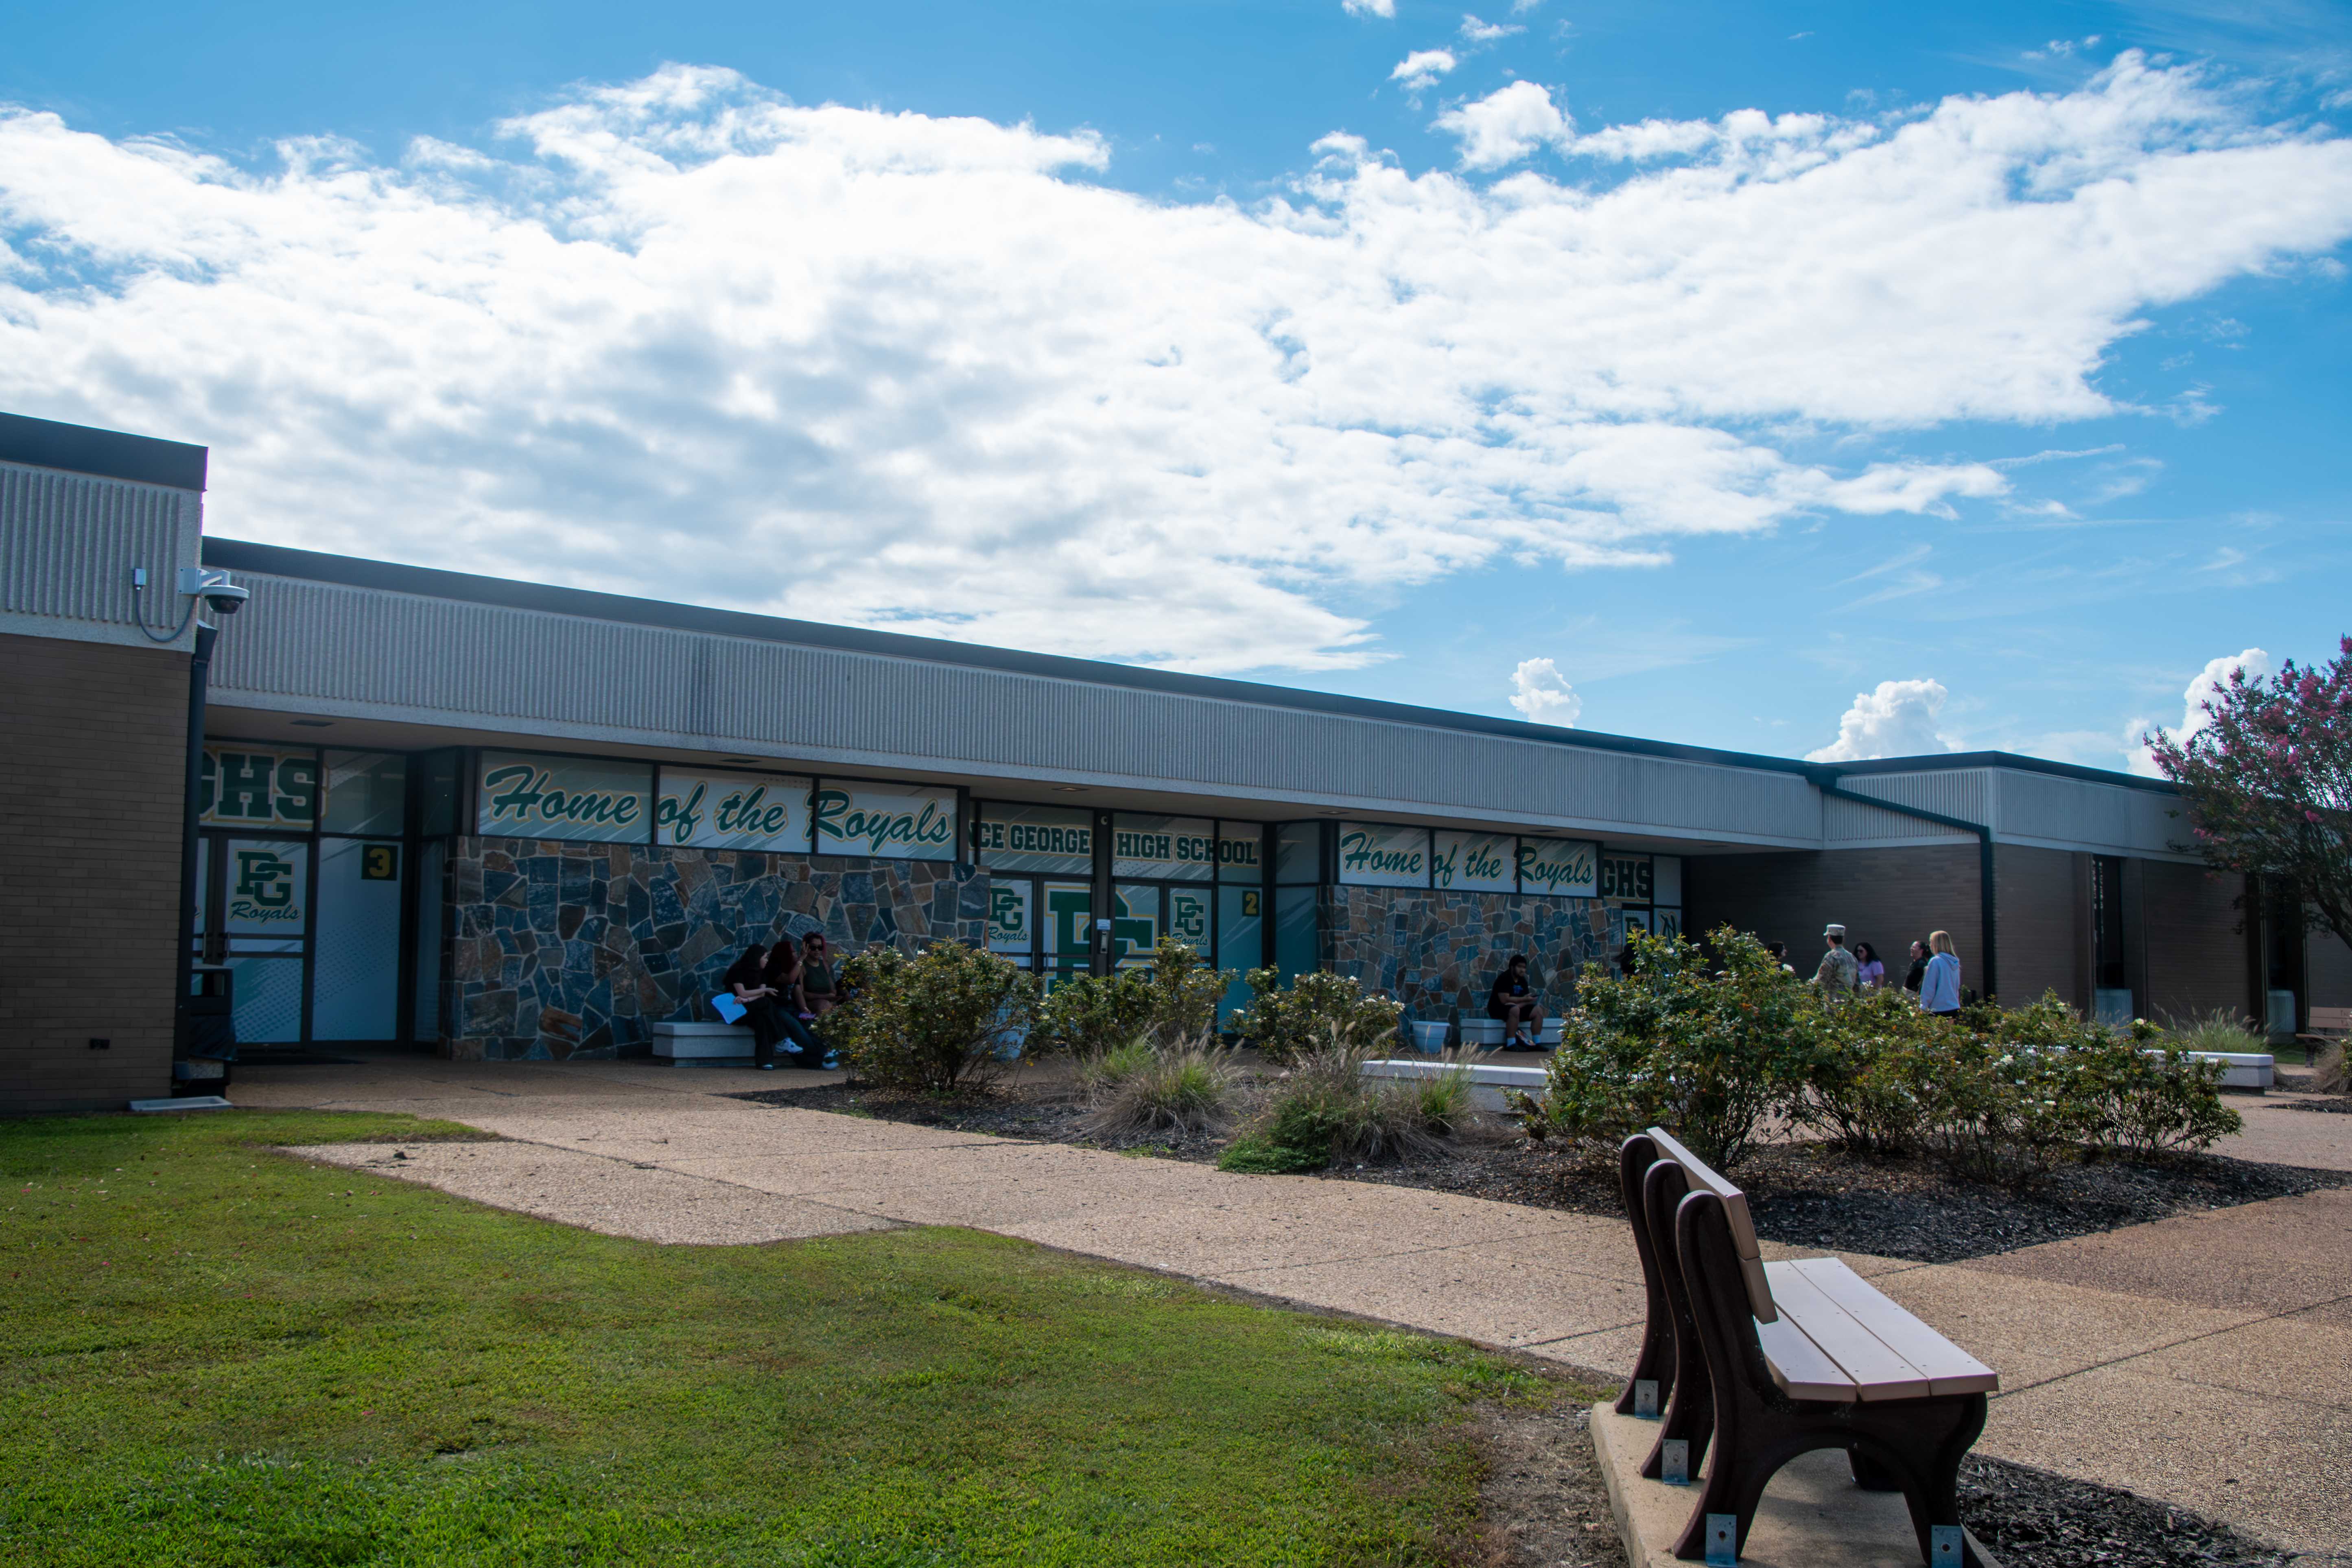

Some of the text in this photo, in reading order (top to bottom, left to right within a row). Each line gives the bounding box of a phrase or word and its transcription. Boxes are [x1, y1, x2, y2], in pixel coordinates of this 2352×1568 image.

[200, 751, 322, 821] HS
[484, 764, 952, 854] Home of the Royals
[368, 847, 391, 878] 3
[1010, 824, 1091, 854] GEORGE
[1116, 832, 1171, 860] HIGH
[1176, 836, 1258, 865] SCHOOL
[1340, 831, 1594, 892] Home of the Royals
[235, 851, 293, 907] PG
[230, 901, 300, 924] Royals
[989, 887, 1023, 931] PG
[1174, 896, 1204, 936] PG
[1245, 892, 1258, 915] 2
[988, 926, 1028, 944] Royals
